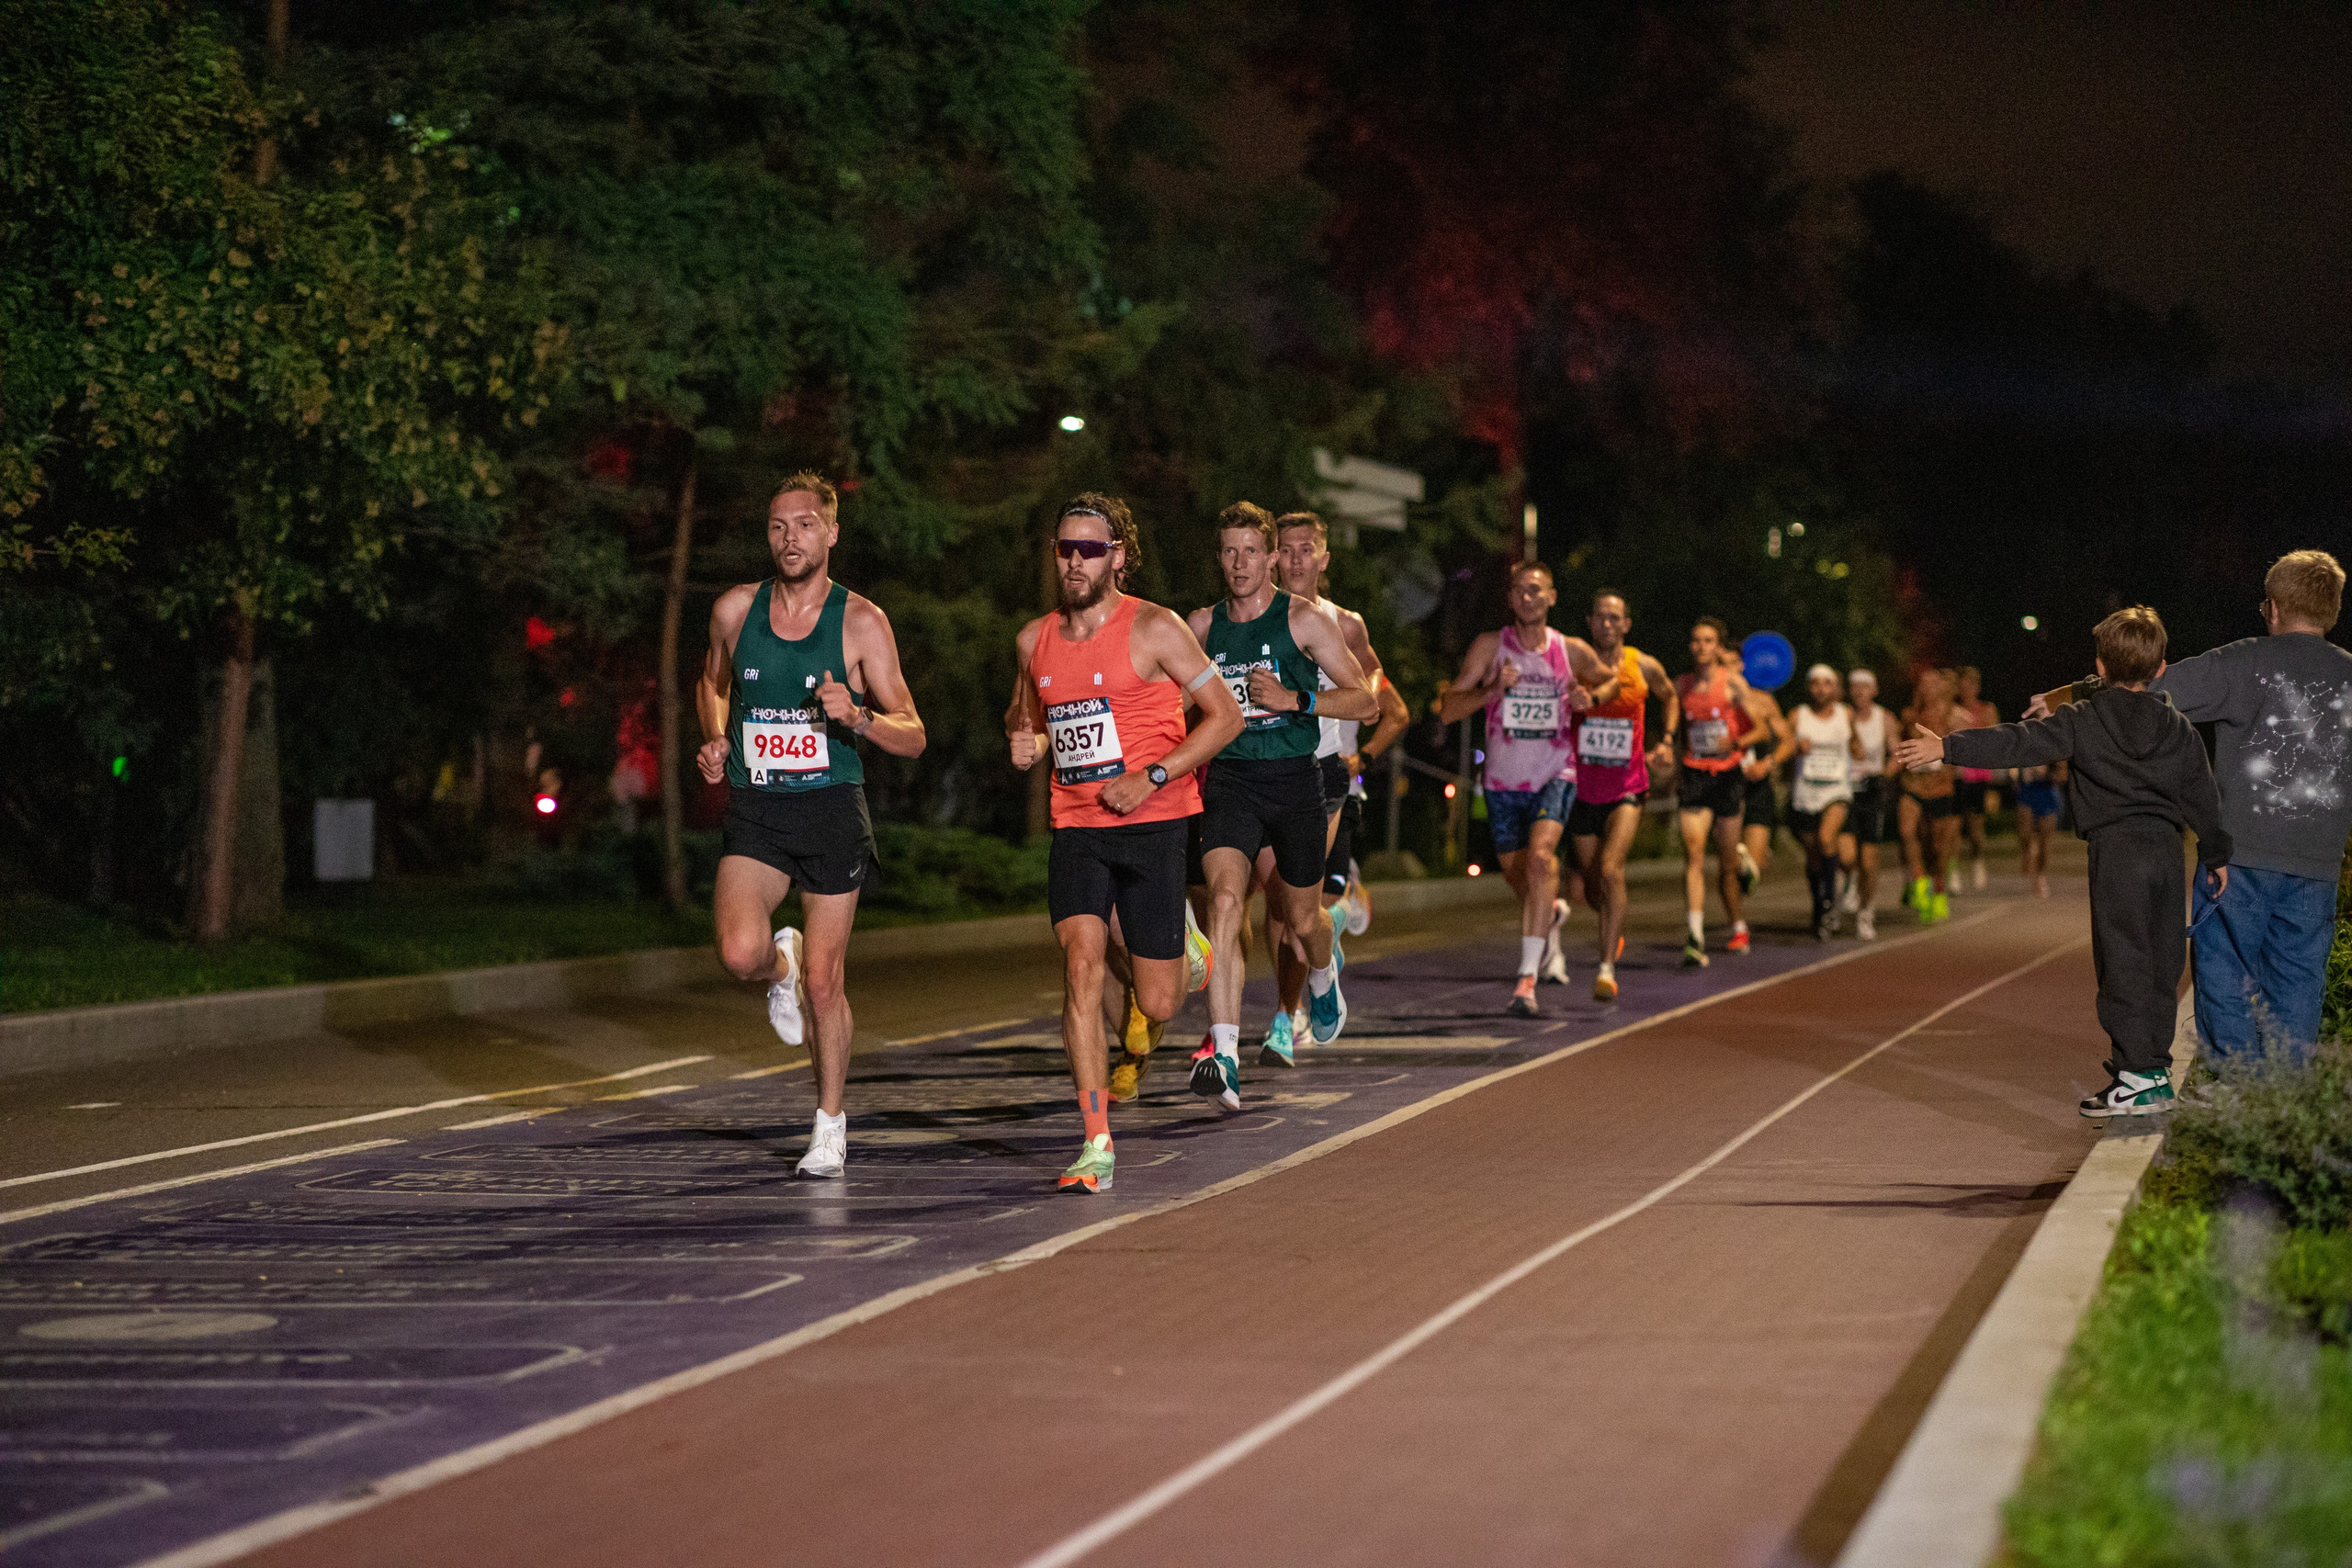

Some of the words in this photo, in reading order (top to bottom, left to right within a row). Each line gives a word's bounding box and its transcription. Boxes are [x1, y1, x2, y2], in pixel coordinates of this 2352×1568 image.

[1512, 703, 1552, 719] 3725
[754, 734, 817, 759] 9848
[1056, 722, 1103, 753] 6357
[1068, 751, 1095, 762] АНДРЕЙ
